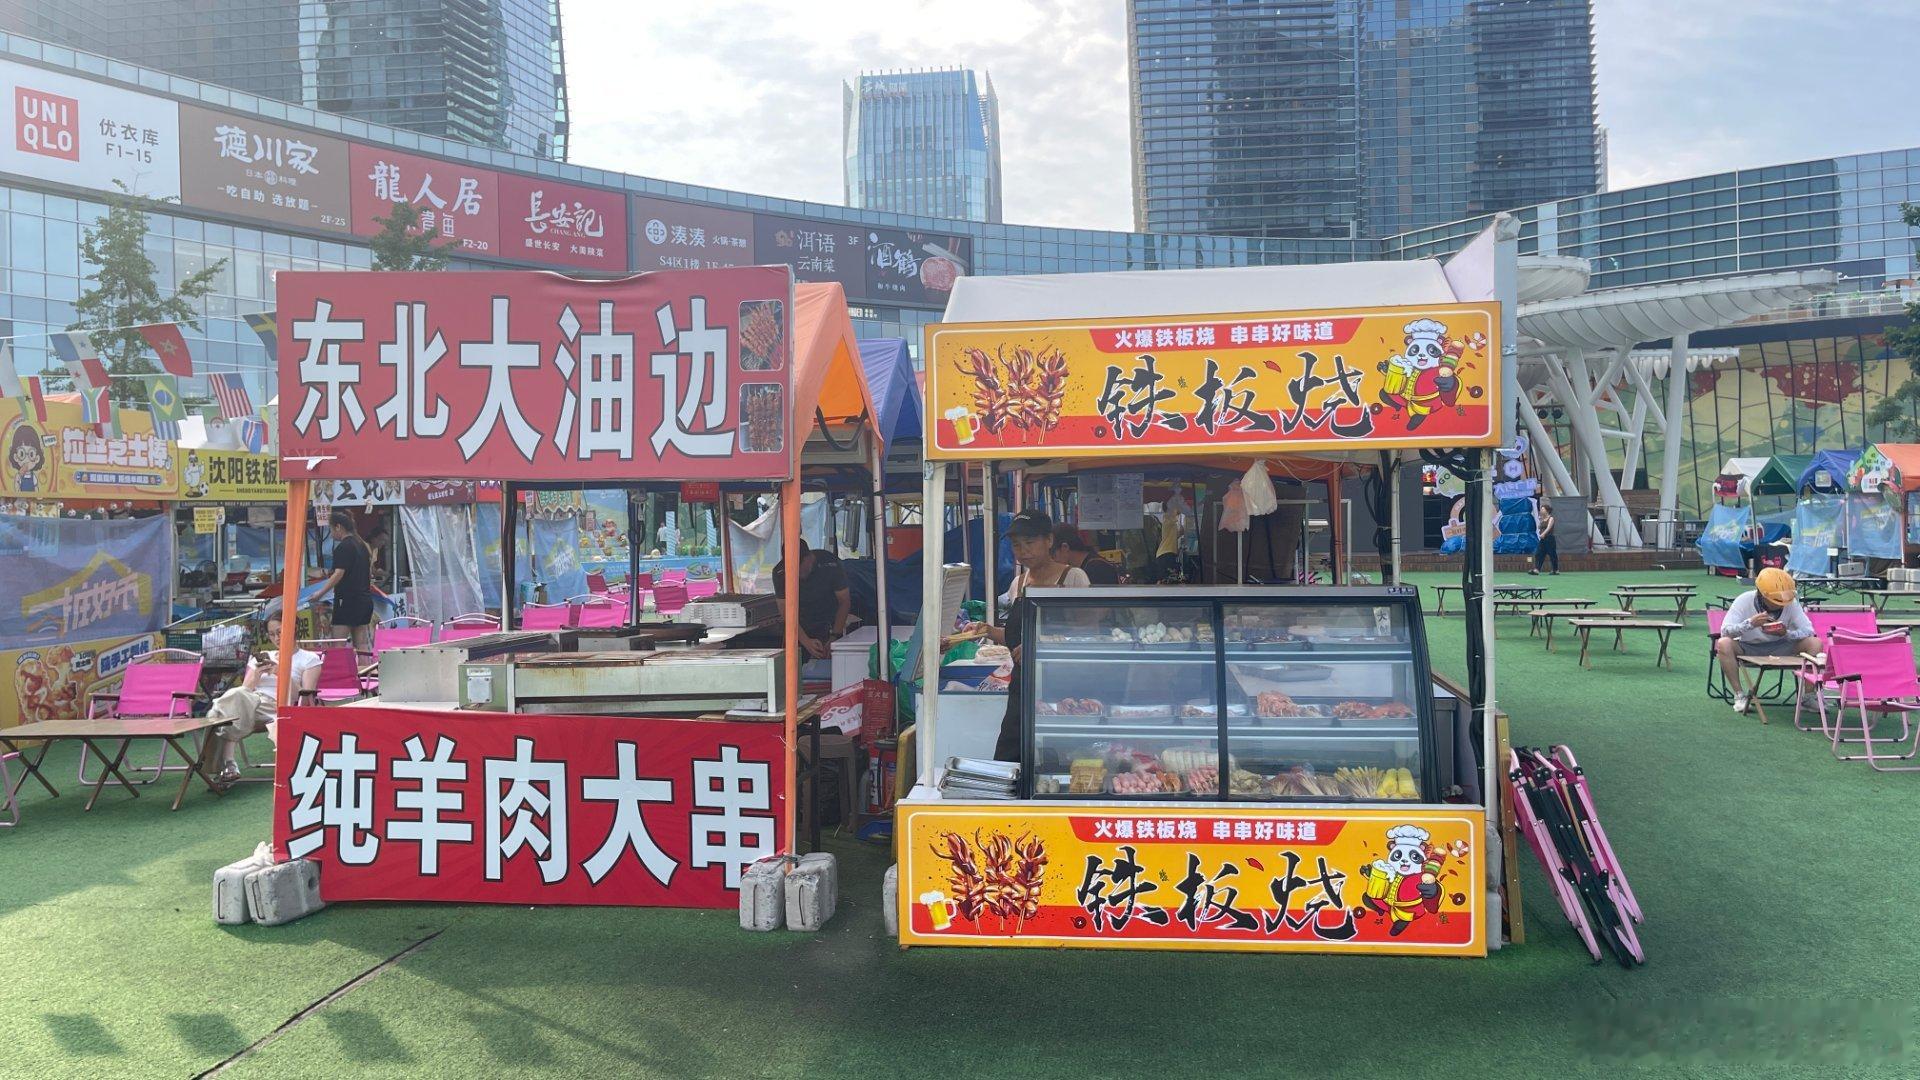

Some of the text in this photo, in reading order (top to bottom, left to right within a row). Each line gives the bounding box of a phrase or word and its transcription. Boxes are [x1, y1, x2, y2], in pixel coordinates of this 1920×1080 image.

[22, 95, 68, 126] UNI
[22, 123, 73, 152] QLO
[99, 118, 160, 147] 优衣库
[105, 142, 153, 164] F1-15
[213, 125, 320, 175] 德川家
[226, 184, 265, 203] 吃自助
[320, 214, 346, 227] 2F-25
[462, 238, 489, 251] F2-20
[797, 230, 860, 253] 洱语 3F
[797, 255, 836, 273] 云南菜
[1114, 321, 1334, 349] 火爆铁板烧 串串好味道
[292, 295, 737, 463] 东北大油边
[1096, 351, 1376, 440] 铁板烧
[209, 456, 287, 485] 沈阳铁板
[285, 731, 778, 890] 纯羊肉大串
[1094, 820, 1318, 843] 火爆铁板烧 串串好味道
[1076, 844, 1358, 942] 铁板烧
